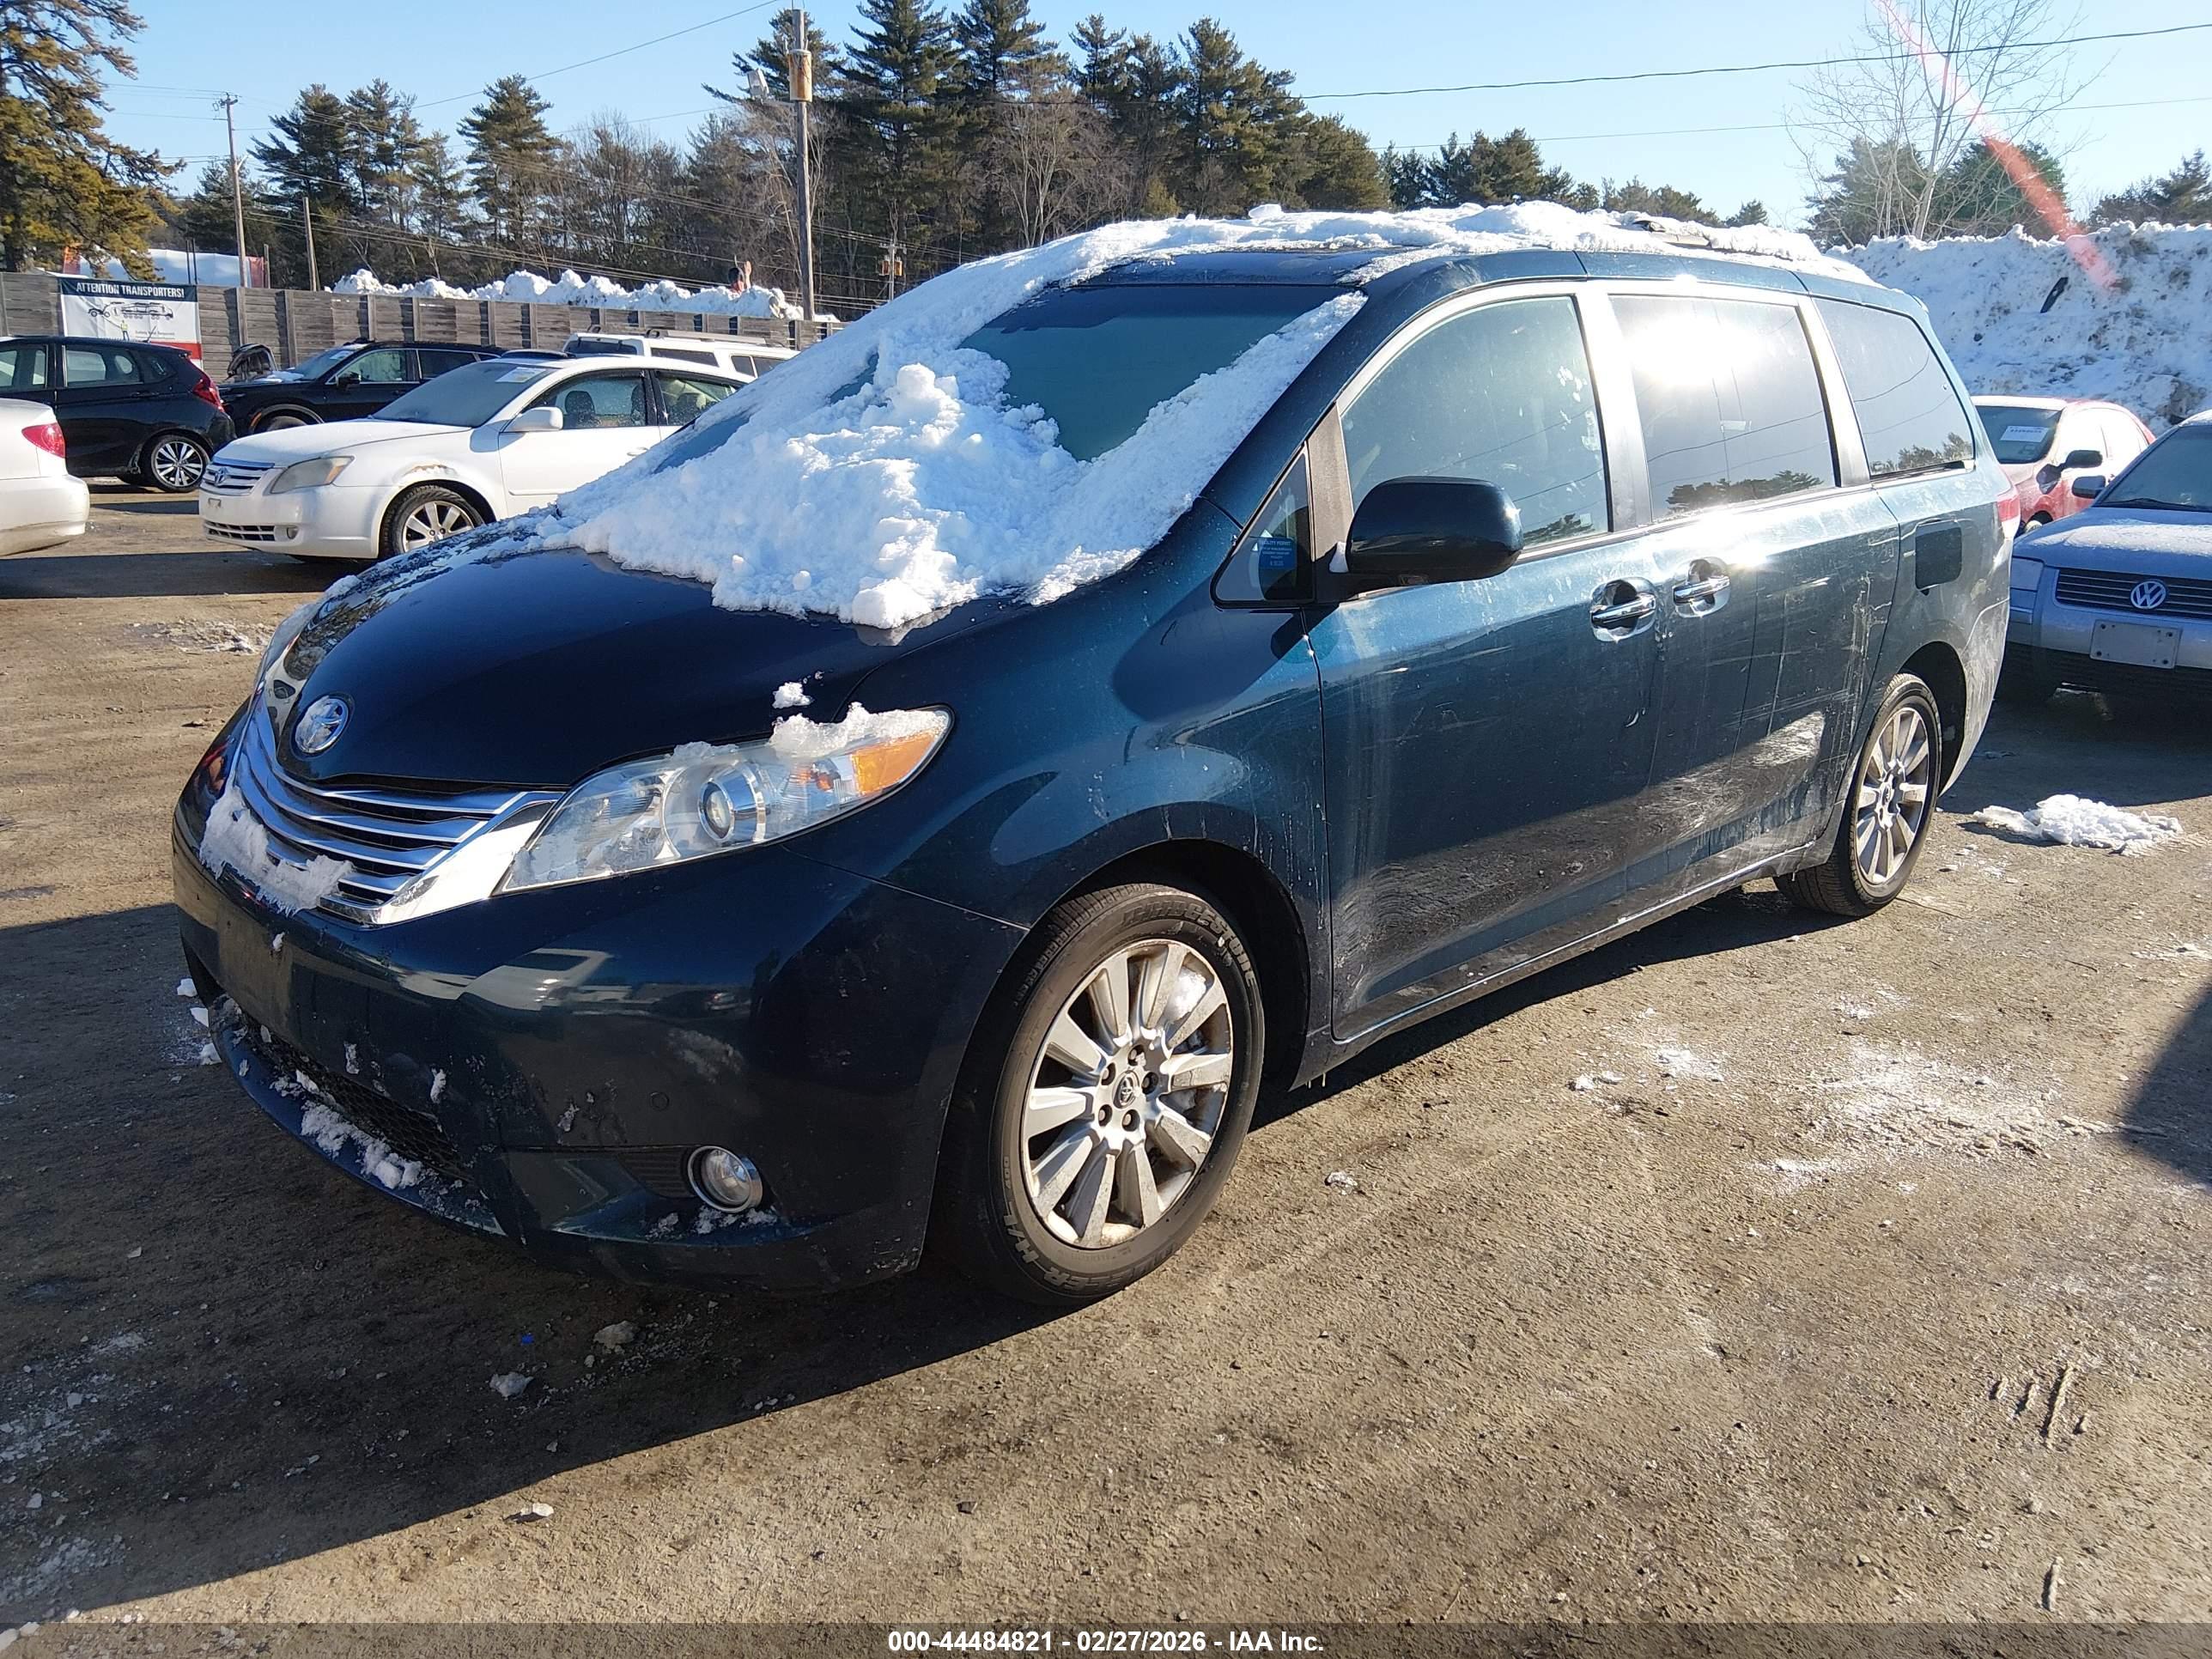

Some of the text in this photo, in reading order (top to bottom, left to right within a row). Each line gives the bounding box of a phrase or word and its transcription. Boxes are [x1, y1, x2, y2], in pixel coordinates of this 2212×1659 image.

[76, 282, 185, 298] ATTENTION TRANSPORTERS!
[1121, 900, 1255, 988] BRIDGESTONE
